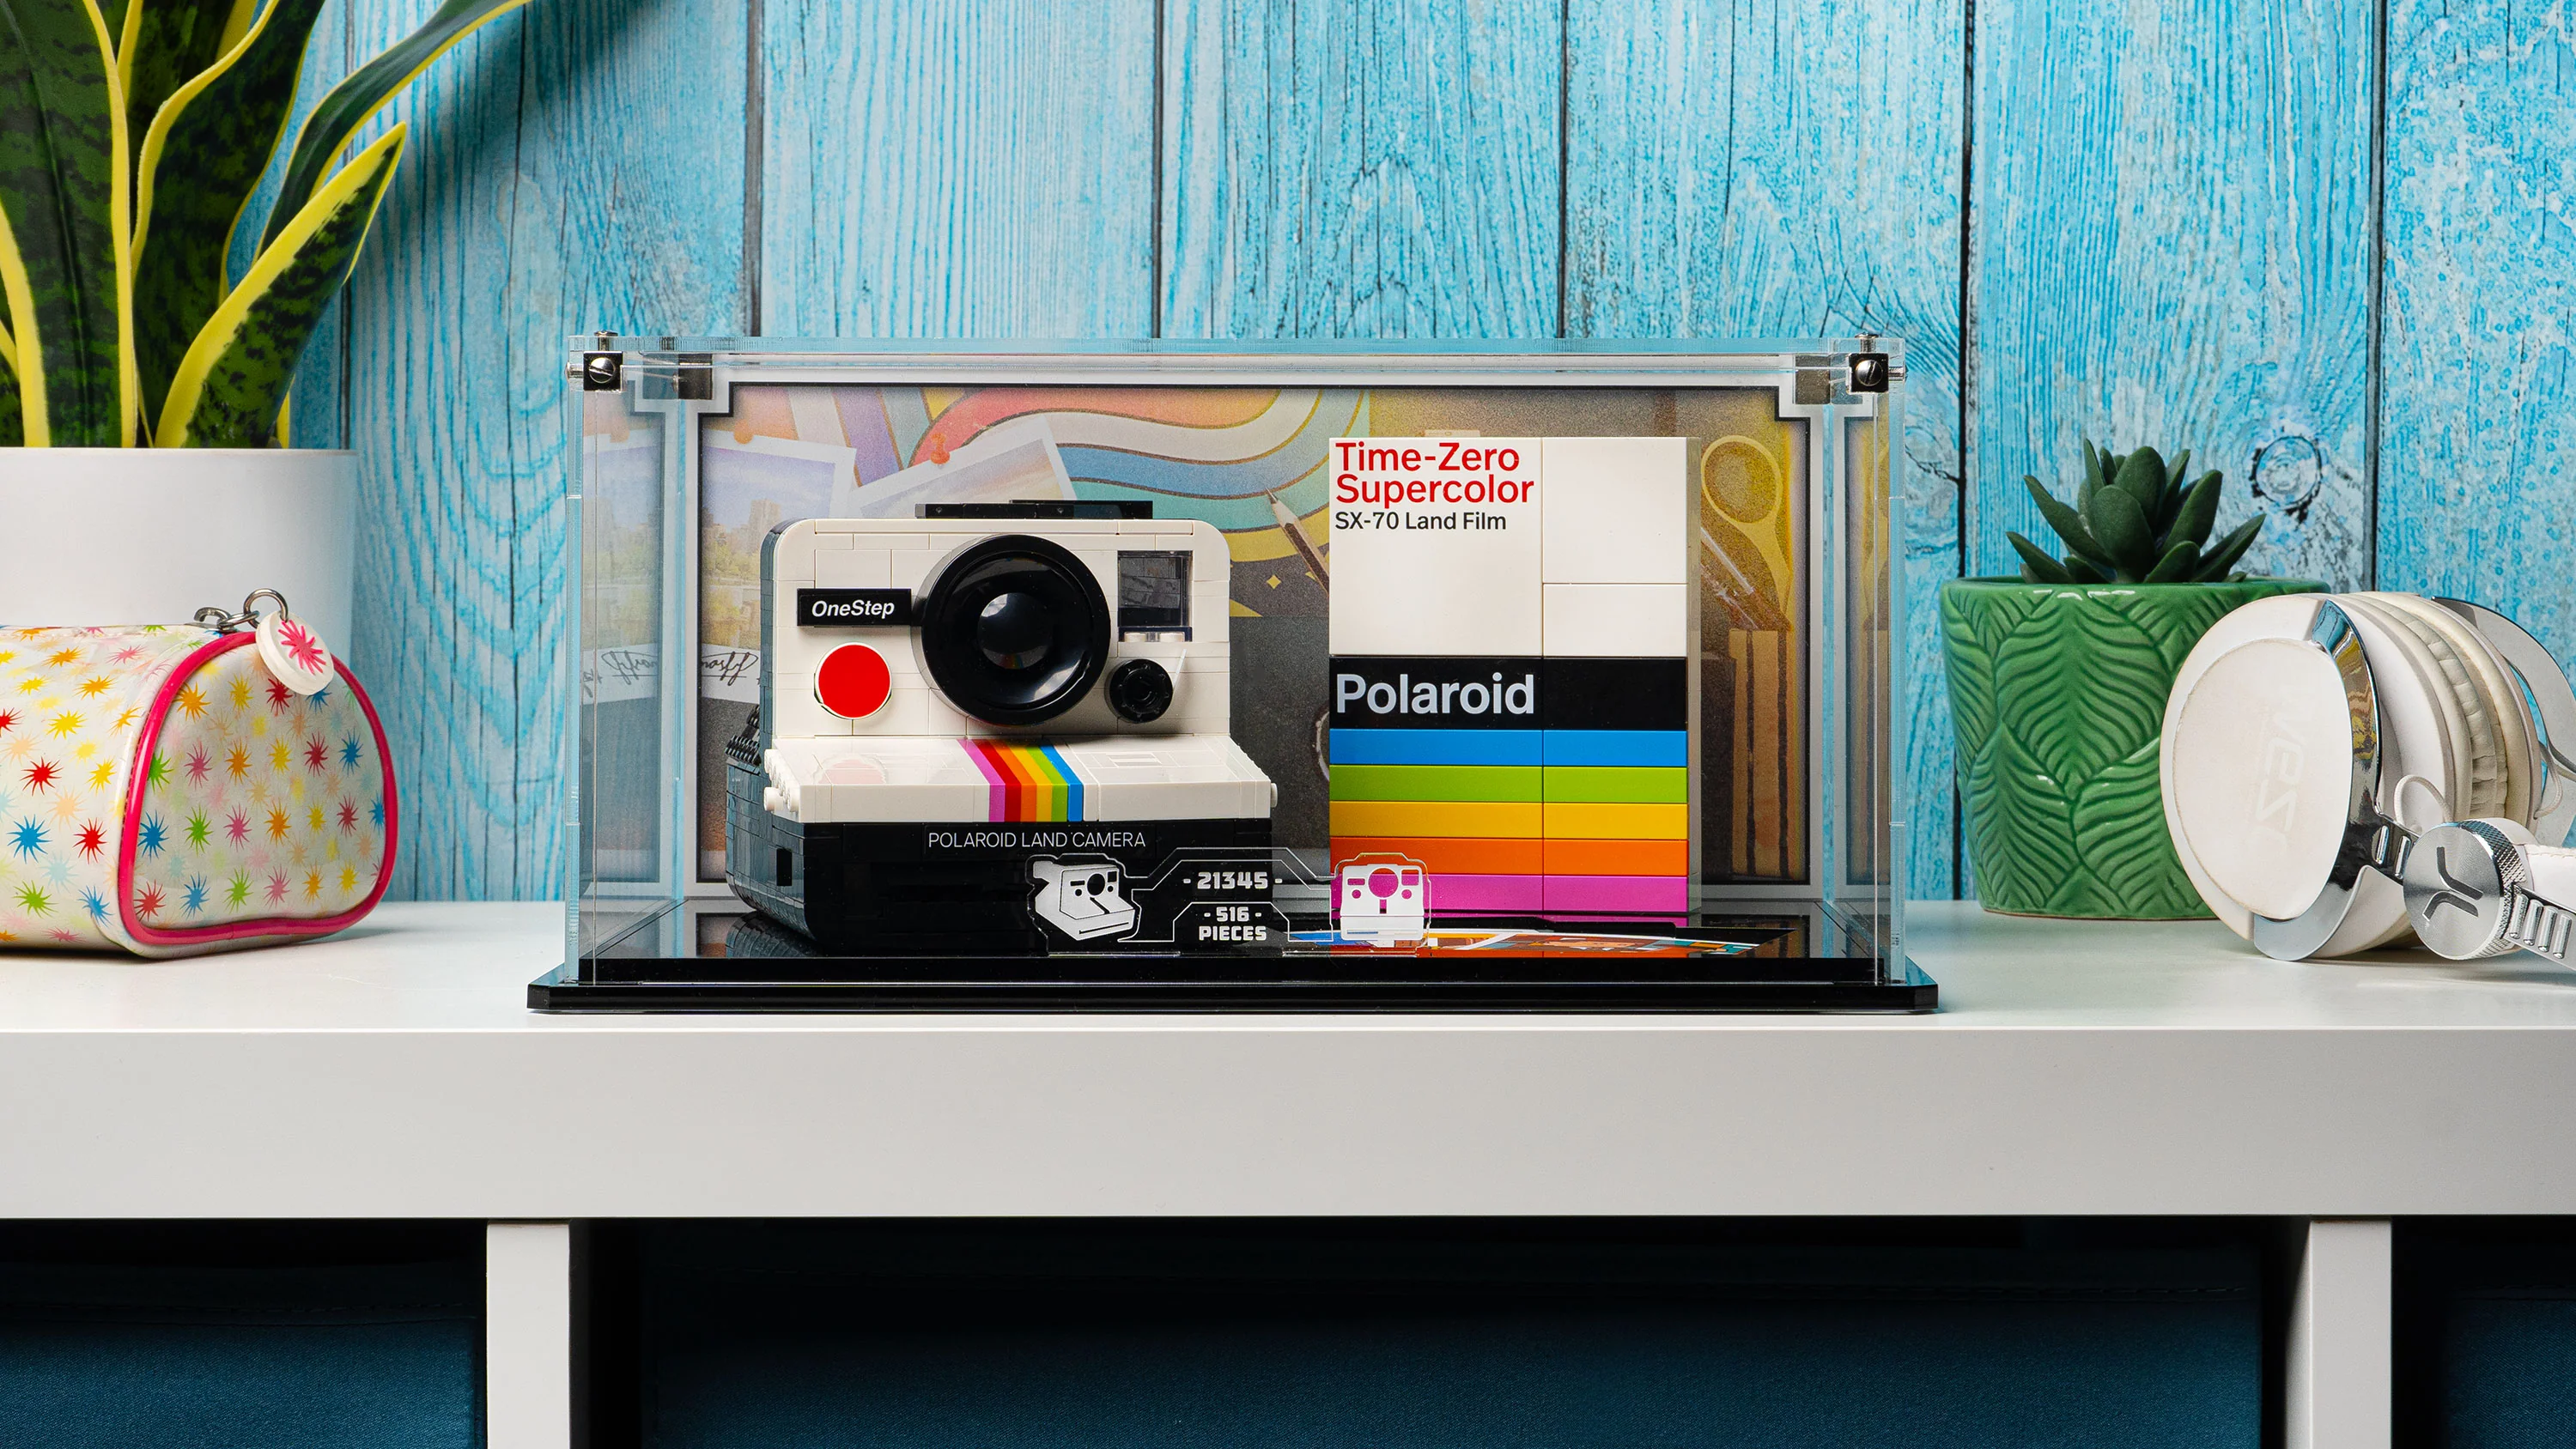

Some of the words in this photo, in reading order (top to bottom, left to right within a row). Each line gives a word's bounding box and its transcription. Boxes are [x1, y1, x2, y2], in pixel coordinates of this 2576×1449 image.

[1335, 441, 1520, 471] Time-Zero
[1336, 474, 1534, 509] Supercolor
[1335, 512, 1400, 530] SX-70
[1406, 512, 1456, 530] Land
[1463, 512, 1506, 530] Film
[811, 599, 895, 619] OneStep
[1336, 672, 1534, 714] Polaroid
[928, 832, 1017, 848] POLAROID
[1022, 832, 1067, 848] LAND
[1072, 832, 1146, 848] CAMERA
[1197, 871, 1268, 889] 21345
[1216, 906, 1249, 922] 516
[1199, 926, 1267, 941] PIECES
